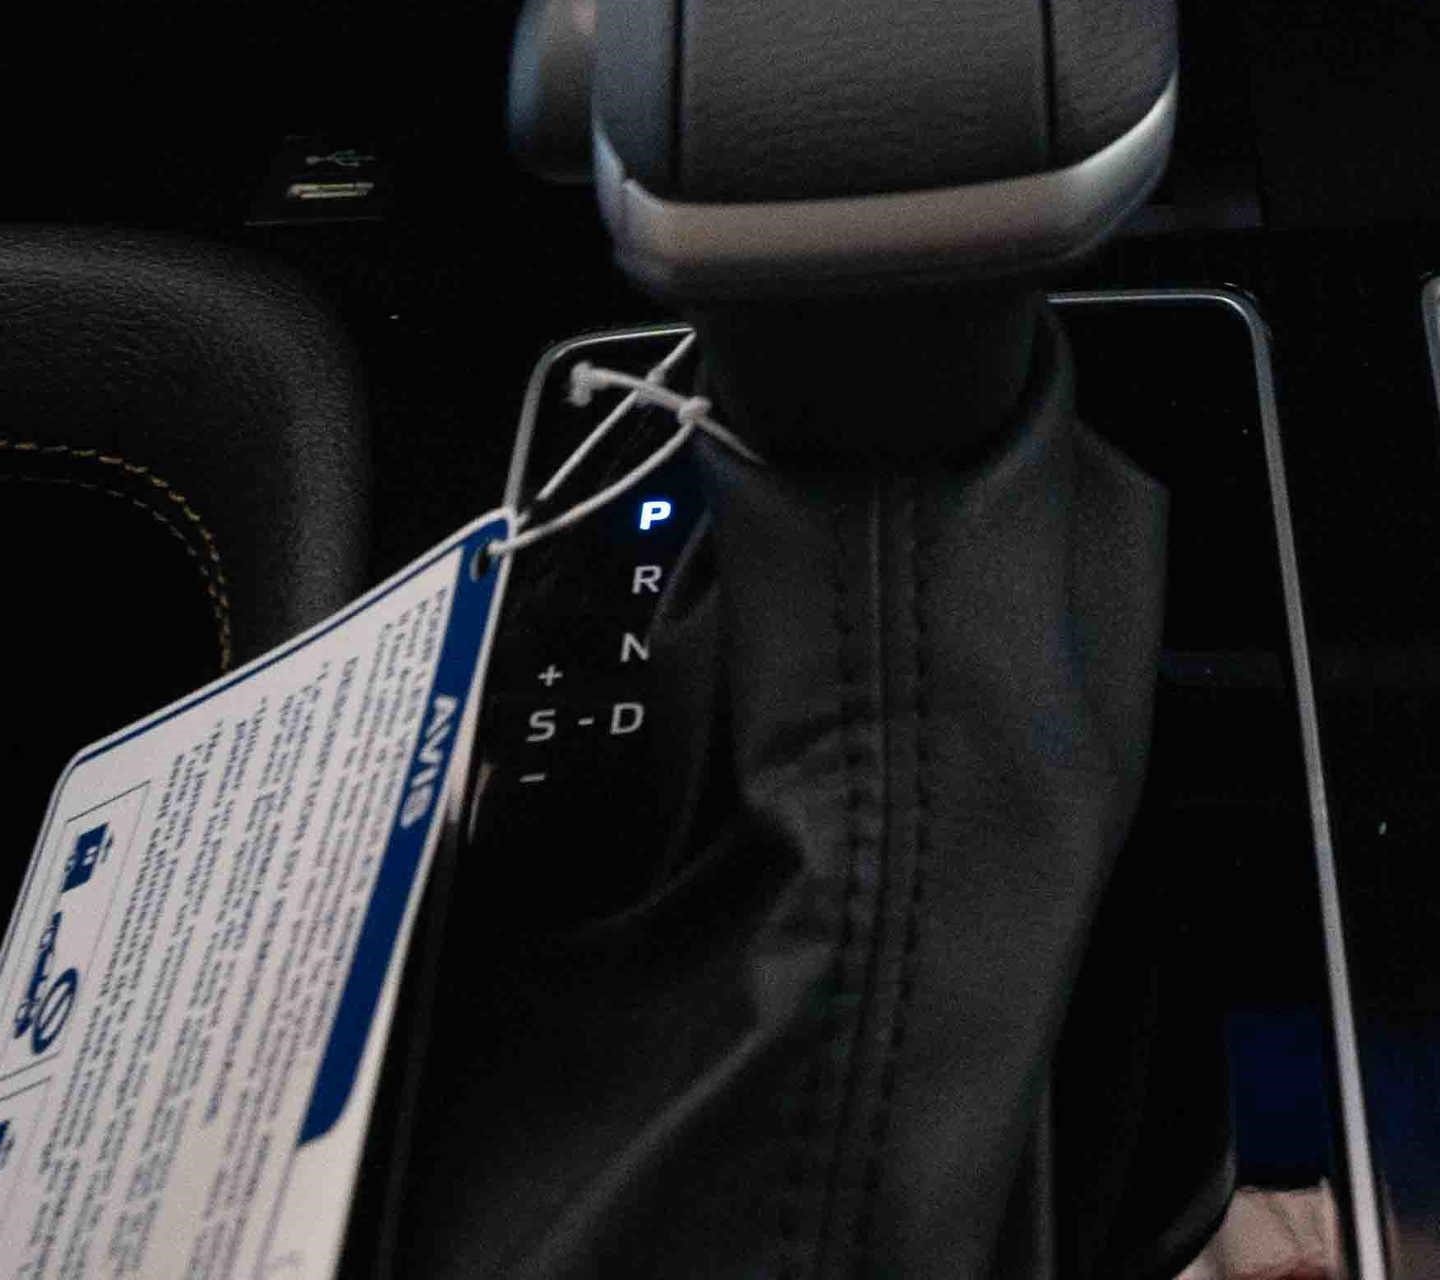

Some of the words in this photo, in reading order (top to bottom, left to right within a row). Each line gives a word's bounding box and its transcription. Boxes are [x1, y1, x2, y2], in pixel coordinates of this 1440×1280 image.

[639, 500, 672, 531] P
[632, 564, 662, 594] R
[620, 632, 649, 662] N
[527, 709, 556, 742] S
[610, 702, 644, 735] D
